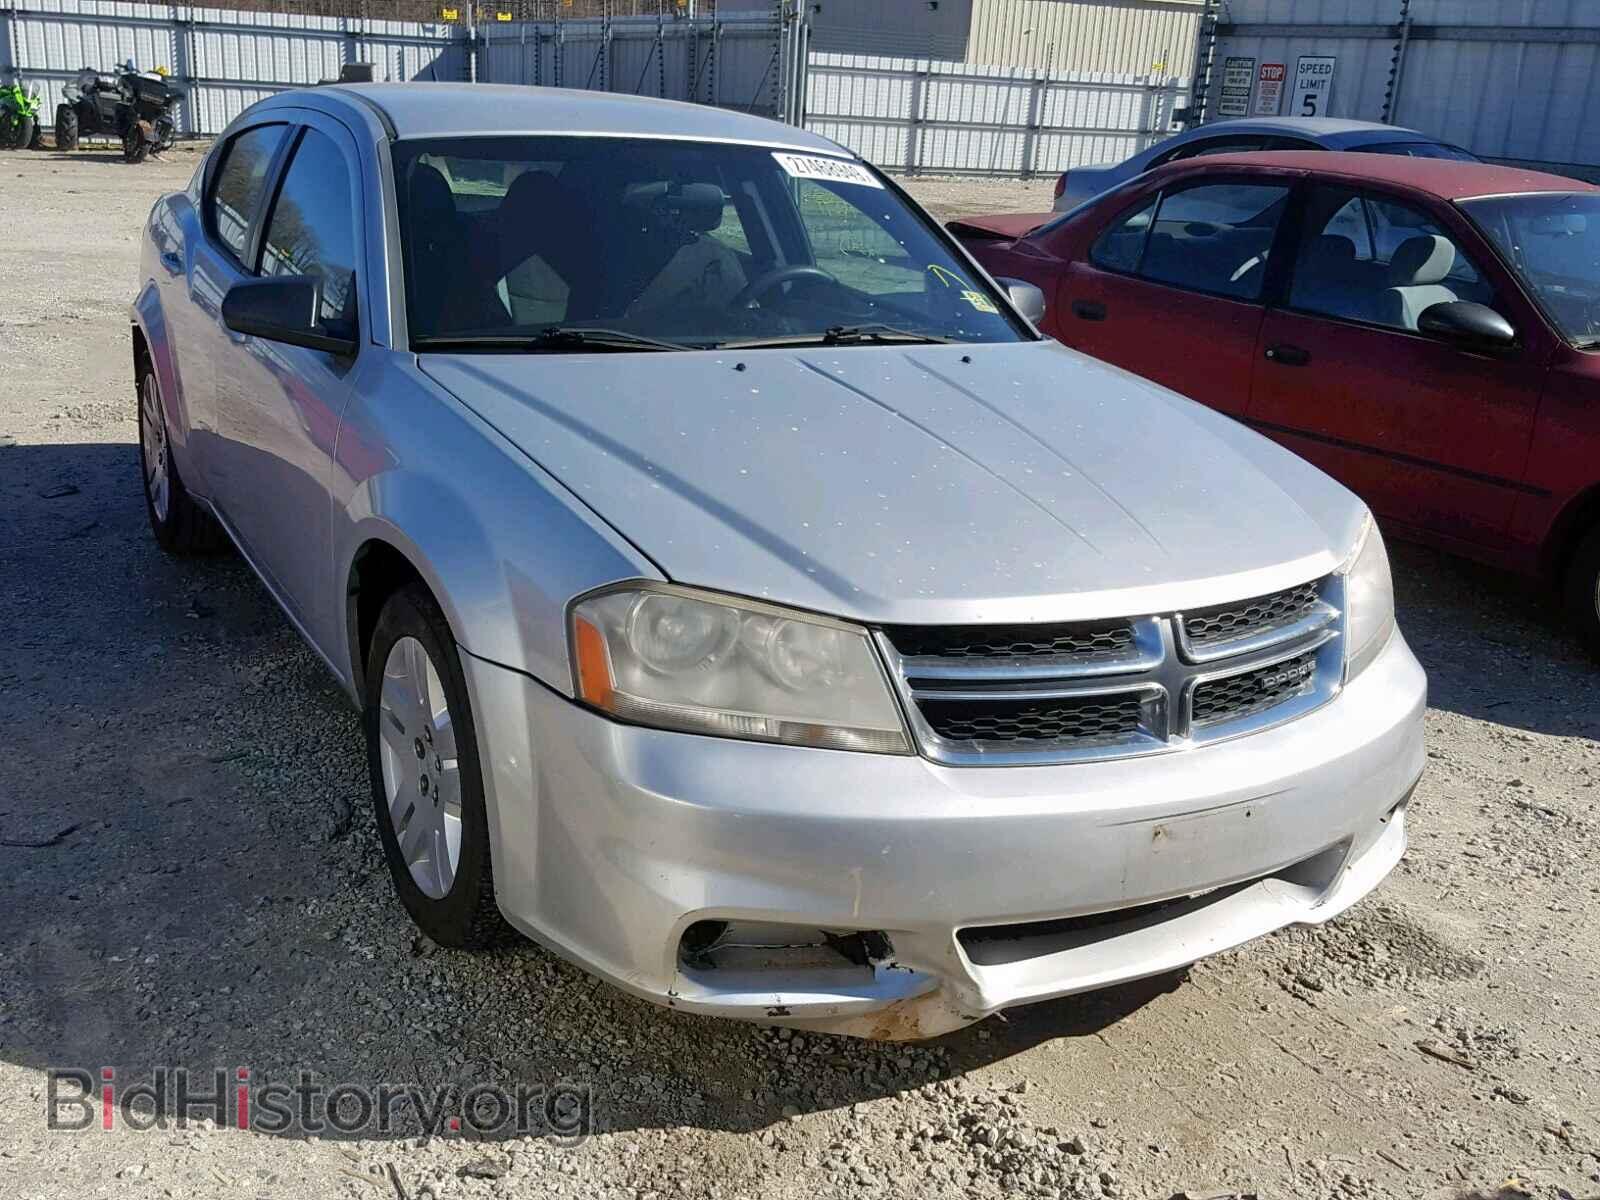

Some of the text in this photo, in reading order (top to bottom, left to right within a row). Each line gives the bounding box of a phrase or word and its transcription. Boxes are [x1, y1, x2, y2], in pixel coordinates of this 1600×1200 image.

[1261, 66, 1283, 79] STOP
[1299, 63, 1332, 75] SPEED
[1299, 79, 1327, 90] LIMIT
[1301, 94, 1318, 117] 5
